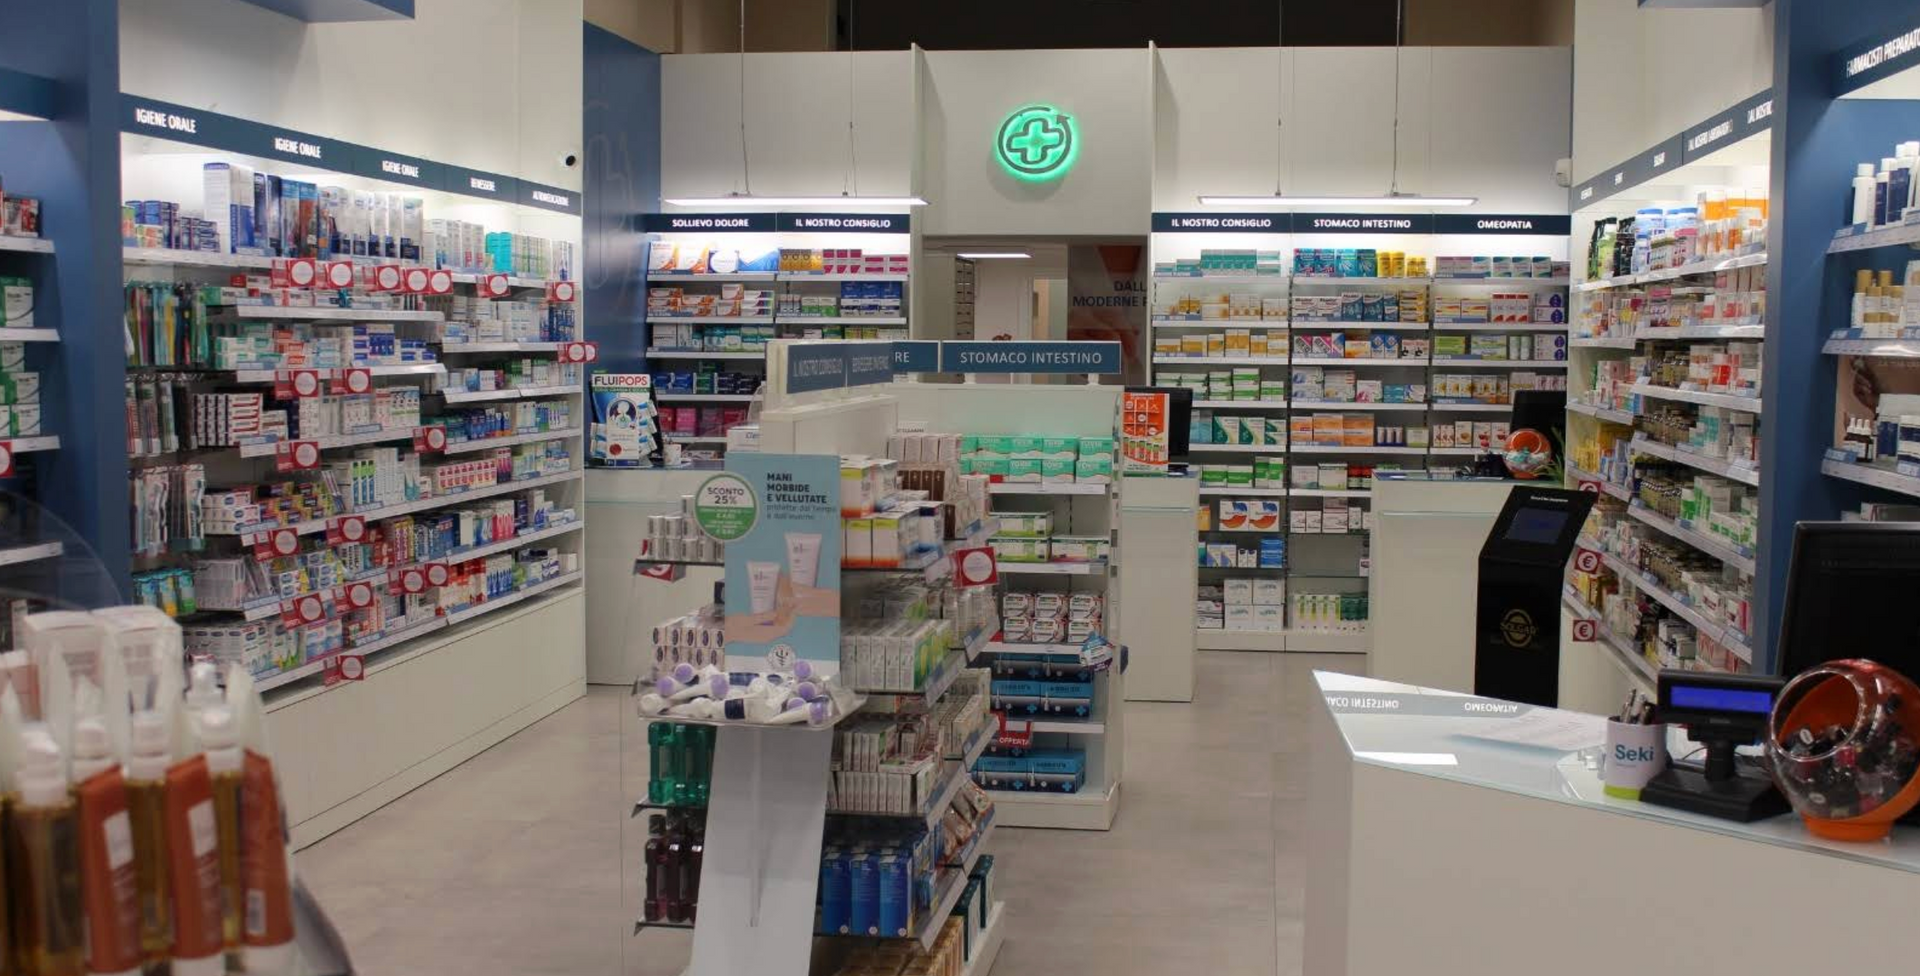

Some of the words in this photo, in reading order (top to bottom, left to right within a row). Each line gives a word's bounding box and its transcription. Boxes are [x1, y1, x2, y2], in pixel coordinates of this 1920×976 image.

[136, 108, 166, 127] IGIENE
[168, 114, 196, 133] ORALE
[274, 138, 299, 154] IGIENE
[299, 142, 322, 159] ORALE
[672, 218, 712, 228] SOLLIEVO
[714, 218, 749, 228] DOLORE
[795, 218, 803, 228] IL
[805, 218, 841, 228] NOSTRO
[843, 219, 891, 229] CONSIGLIO
[1171, 218, 1181, 228] IL
[1182, 218, 1220, 228] NOSTRO
[1221, 218, 1271, 228] CONSIGLIO
[1314, 218, 1360, 228] STOMACO
[1362, 219, 1411, 229] INTESTINO
[1477, 220, 1532, 230] OMEOPATIA
[1072, 295, 1139, 307] MODERNE
[960, 351, 1027, 364] STOMACO
[1031, 351, 1102, 364] INTESTINO
[594, 375, 648, 386] FLUIPOPS
[766, 473, 792, 482] MANI
[707, 487, 745, 496] SCONTO
[766, 483, 810, 493] MORBIDE
[714, 495, 737, 505] 25%
[766, 493, 773, 502] E
[775, 494, 827, 504] VELLUTATE
[999, 736, 1031, 746] OFFERTA
[1614, 744, 1654, 762] Seki
